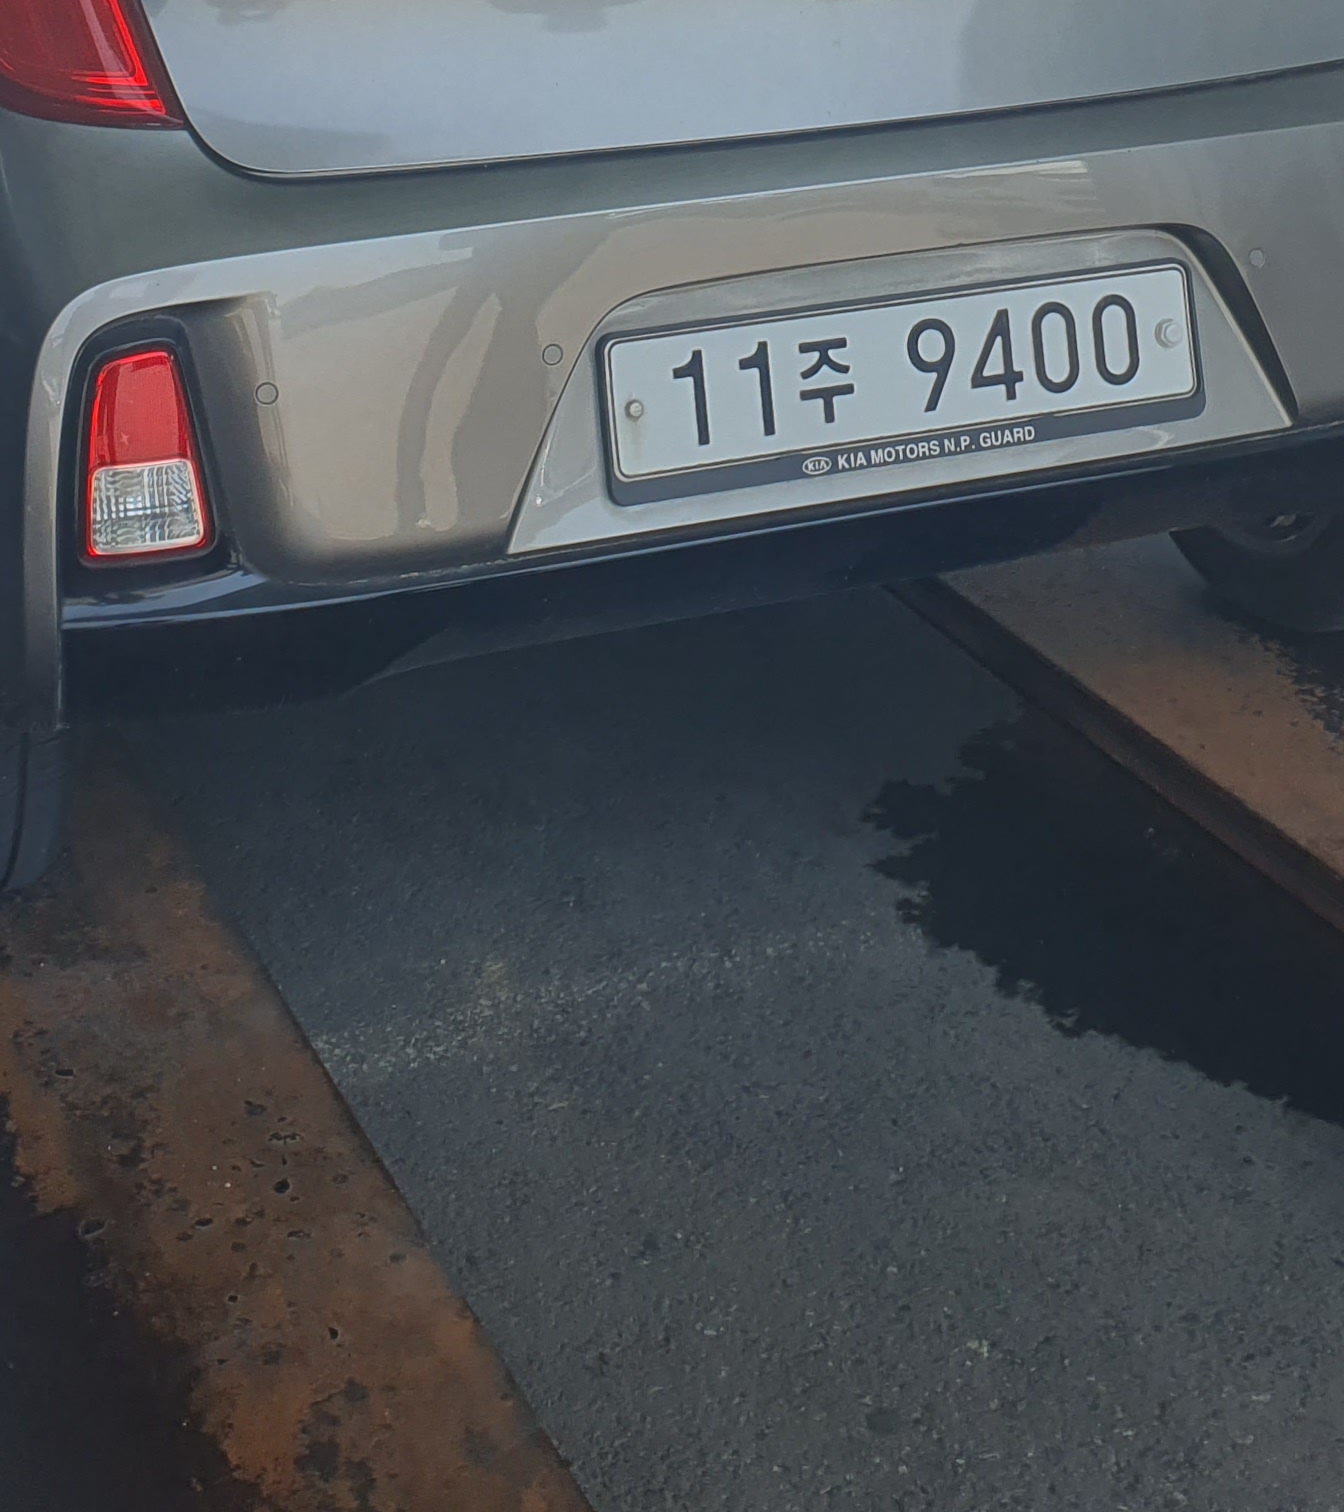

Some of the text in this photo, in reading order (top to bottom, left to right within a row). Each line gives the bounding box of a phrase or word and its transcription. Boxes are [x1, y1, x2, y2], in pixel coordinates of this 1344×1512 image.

[671, 293, 1140, 446] 11주 9400
[837, 454, 868, 470] KIA
[870, 441, 941, 465] MOTORS
[944, 435, 976, 455] N.P.
[979, 425, 1036, 448] GUARD
